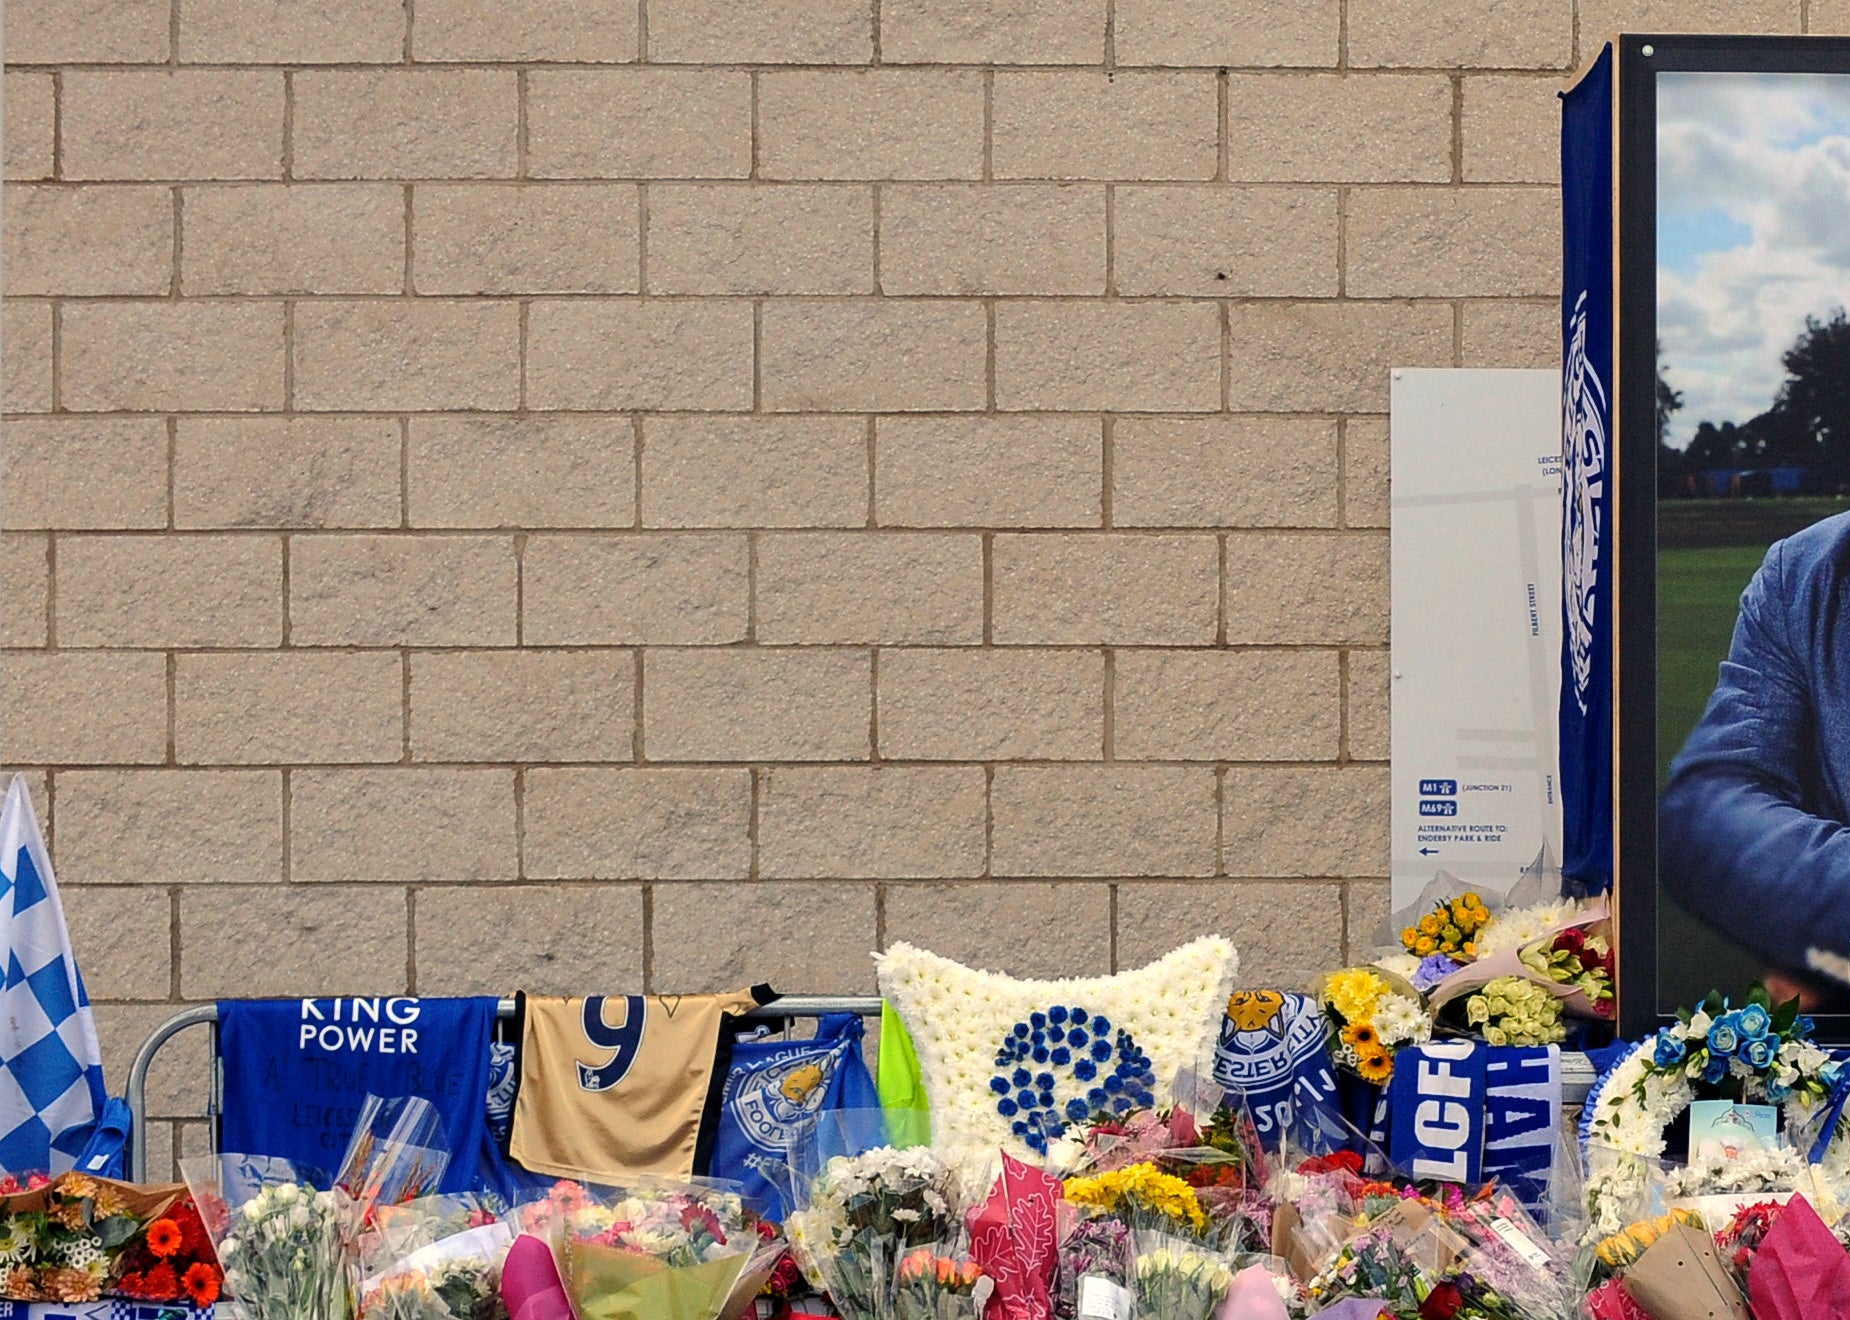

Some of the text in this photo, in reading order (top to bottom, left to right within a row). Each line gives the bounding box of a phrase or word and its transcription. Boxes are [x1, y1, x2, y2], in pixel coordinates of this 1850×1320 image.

[1527, 583, 1537, 607] STREET
[1422, 783, 1437, 793] M1
[1421, 804, 1442, 814] M69
[1417, 825, 1467, 833] ALTERNATIVE
[1469, 825, 1493, 833] ROUTE
[1417, 835, 1451, 843] ENDERBY
[301, 997, 421, 1025] KING
[299, 1024, 418, 1054] POWER
[576, 995, 648, 1093] 9
